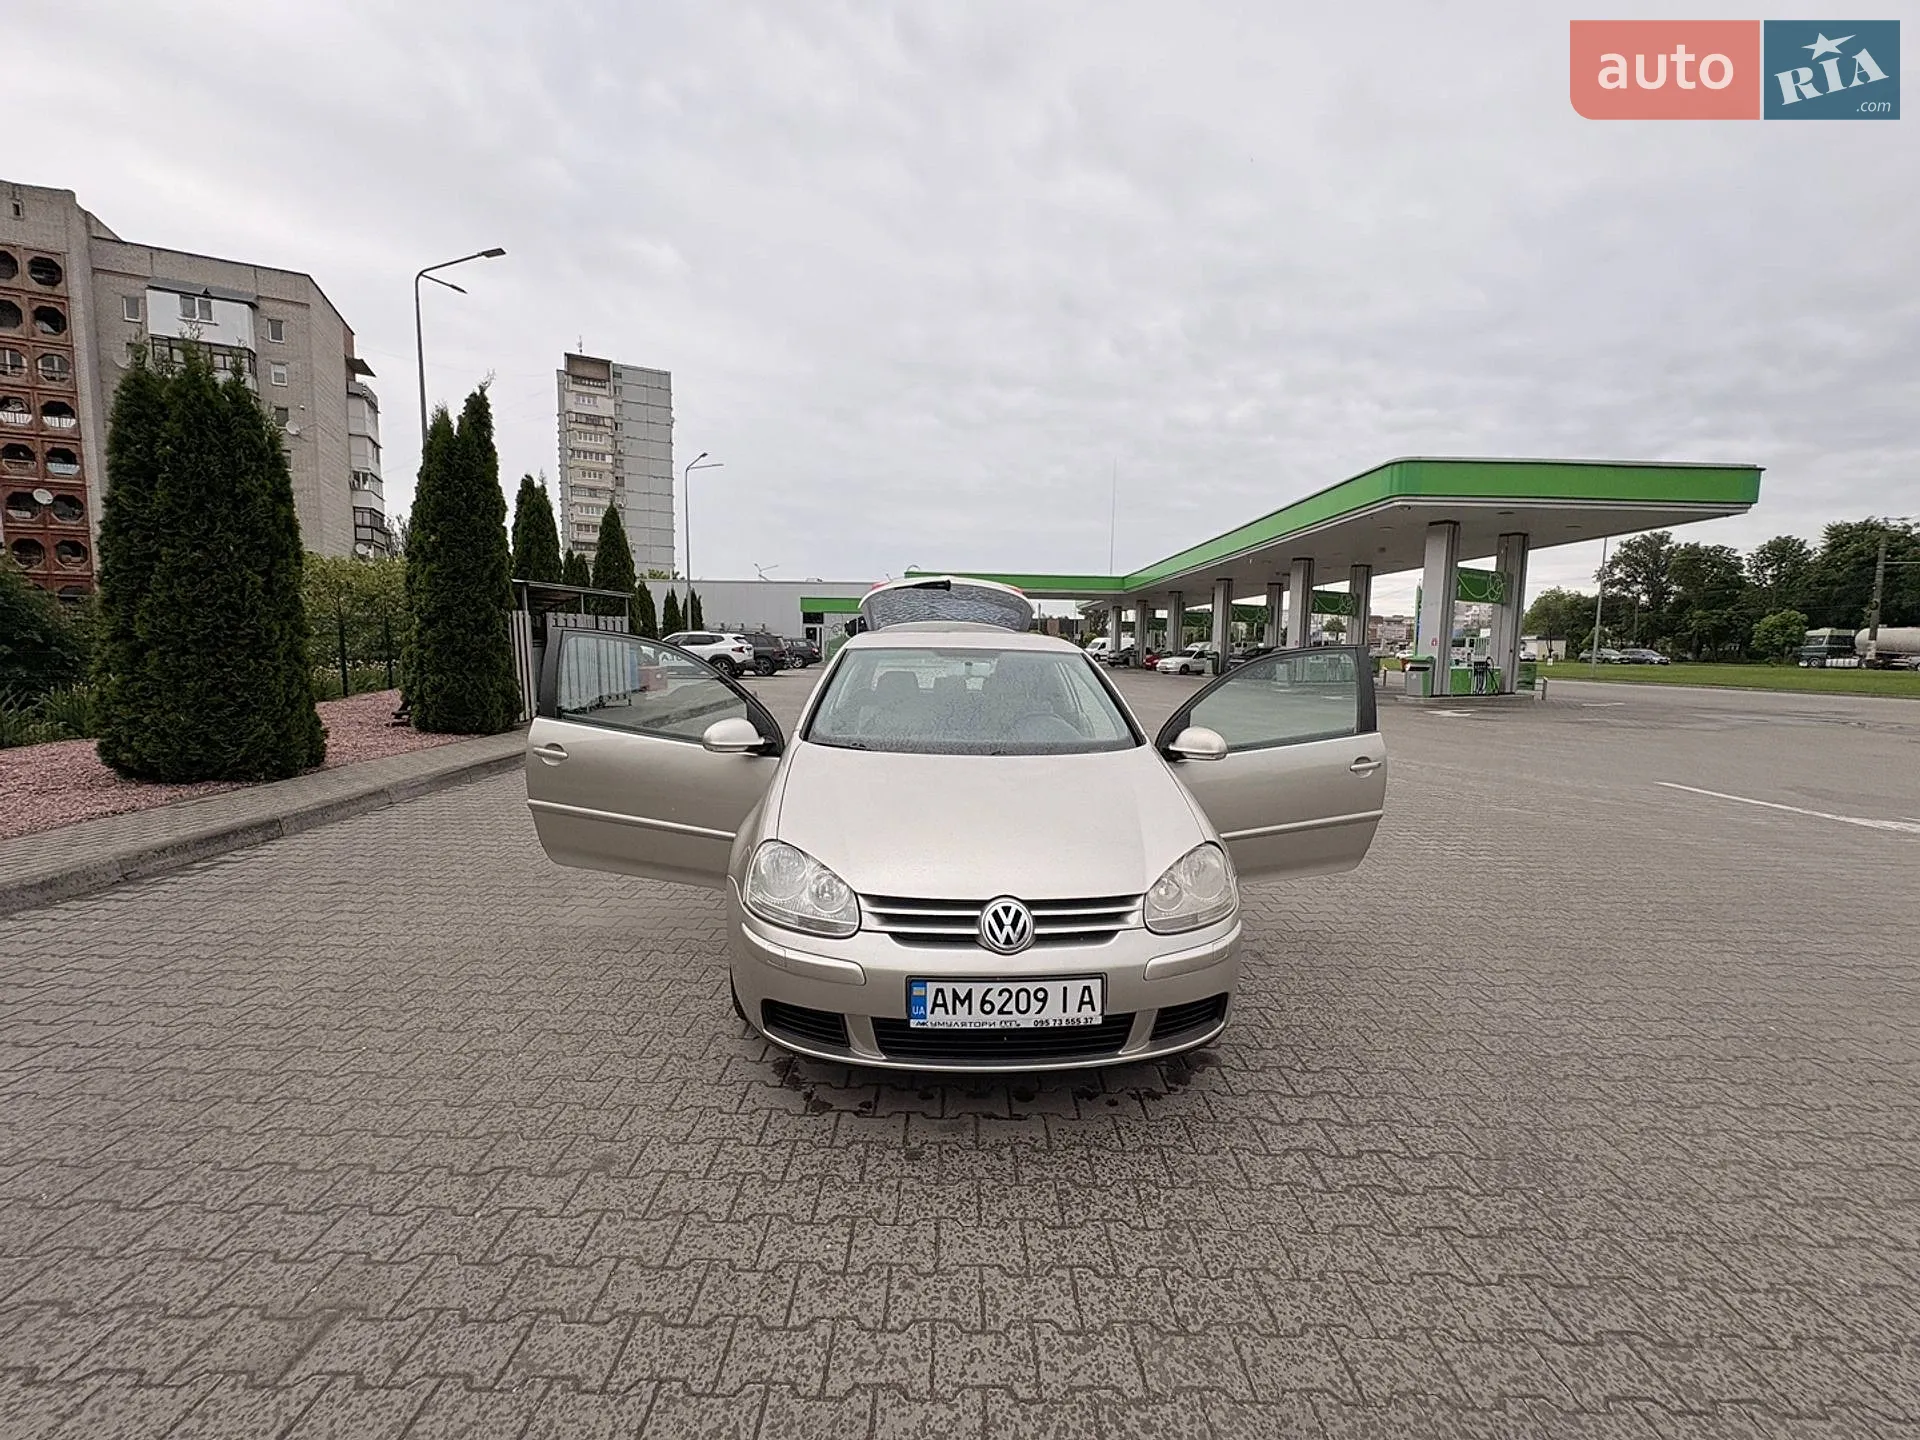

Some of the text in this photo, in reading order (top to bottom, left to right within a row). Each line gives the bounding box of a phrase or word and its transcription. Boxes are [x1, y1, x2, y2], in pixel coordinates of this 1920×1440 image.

[929, 985, 1096, 1015] AM 6209 IA
[912, 1006, 926, 1015] UA
